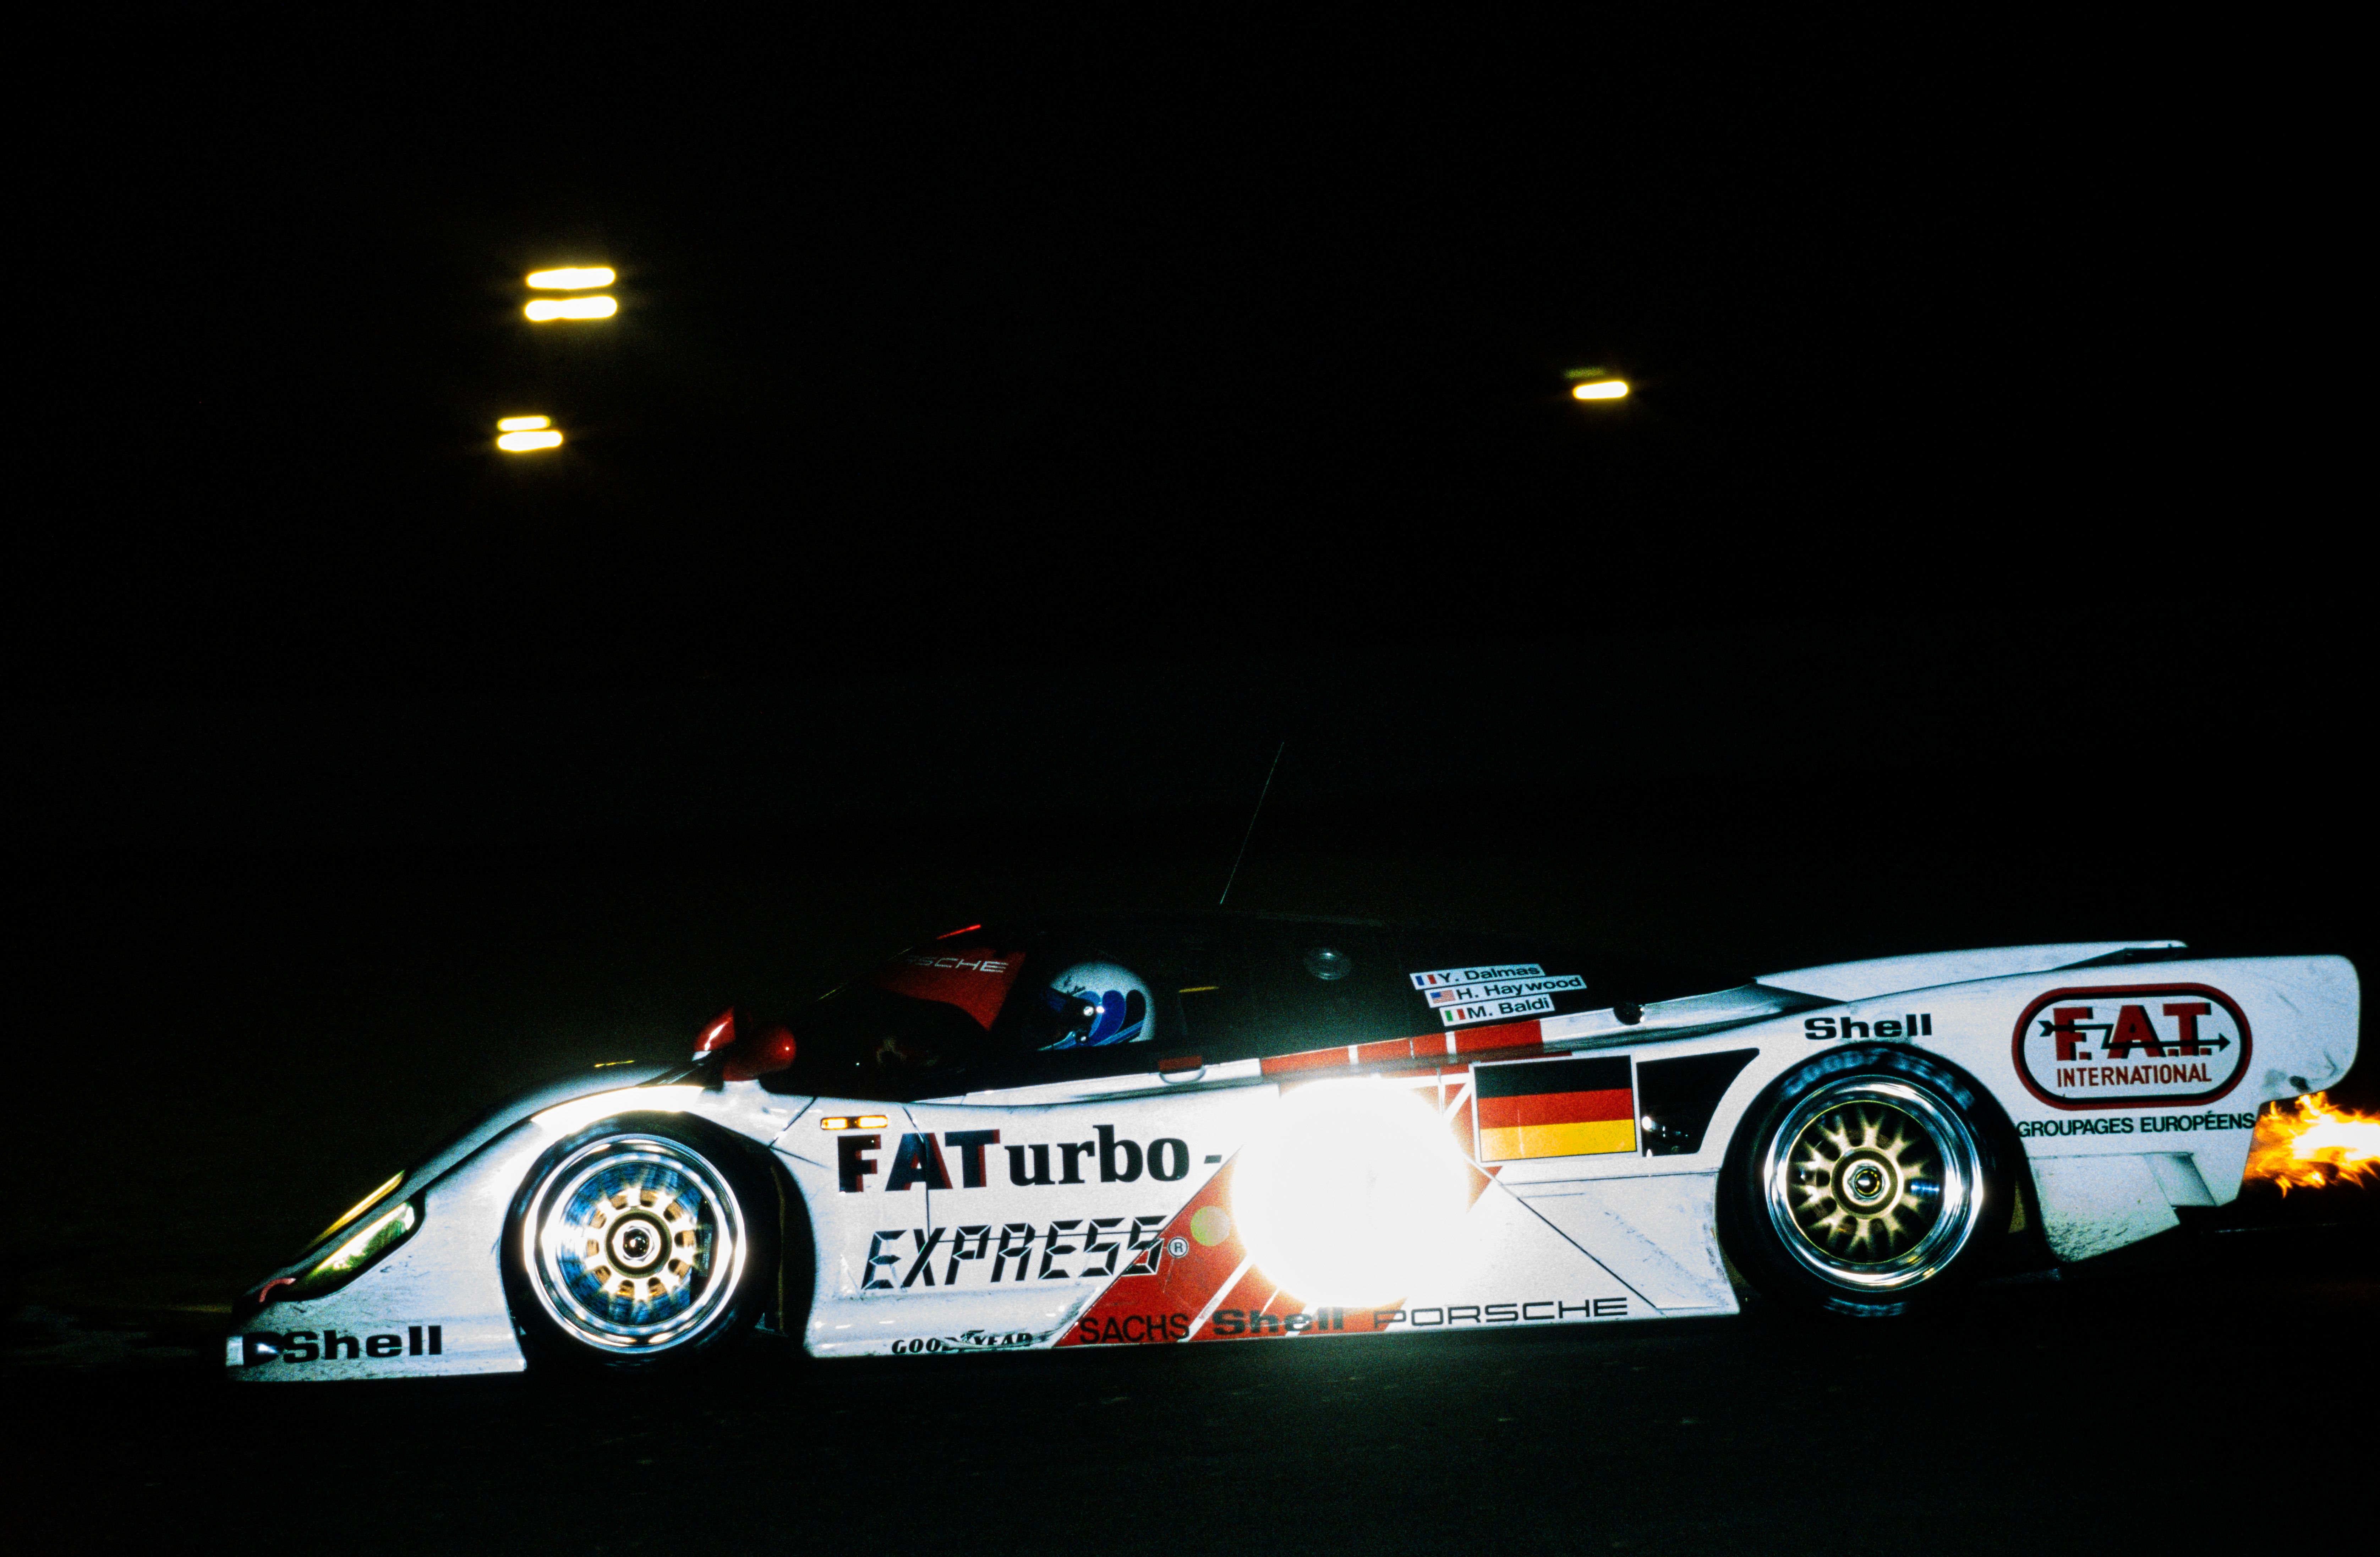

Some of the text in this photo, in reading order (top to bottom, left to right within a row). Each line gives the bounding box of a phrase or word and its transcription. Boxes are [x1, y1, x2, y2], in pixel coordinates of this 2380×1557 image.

[1438, 965, 1541, 983] Y. Dalmas
[1457, 978, 1581, 1000] H. Haywood
[1467, 997, 1550, 1019] M. Baldi
[1804, 1013, 1932, 1040] Shell
[2053, 1002, 2212, 1061] F.A.T.
[2057, 1063, 2212, 1087] INTERNATIONAL
[2017, 1110, 2256, 1137] GROUPAGES EUROPÉENS
[1213, 1307, 1344, 1336] Shell
[1374, 1297, 1627, 1328] PORSCHE
[1079, 1313, 1190, 1344] SACHS
[284, 1325, 442, 1363] Shell
